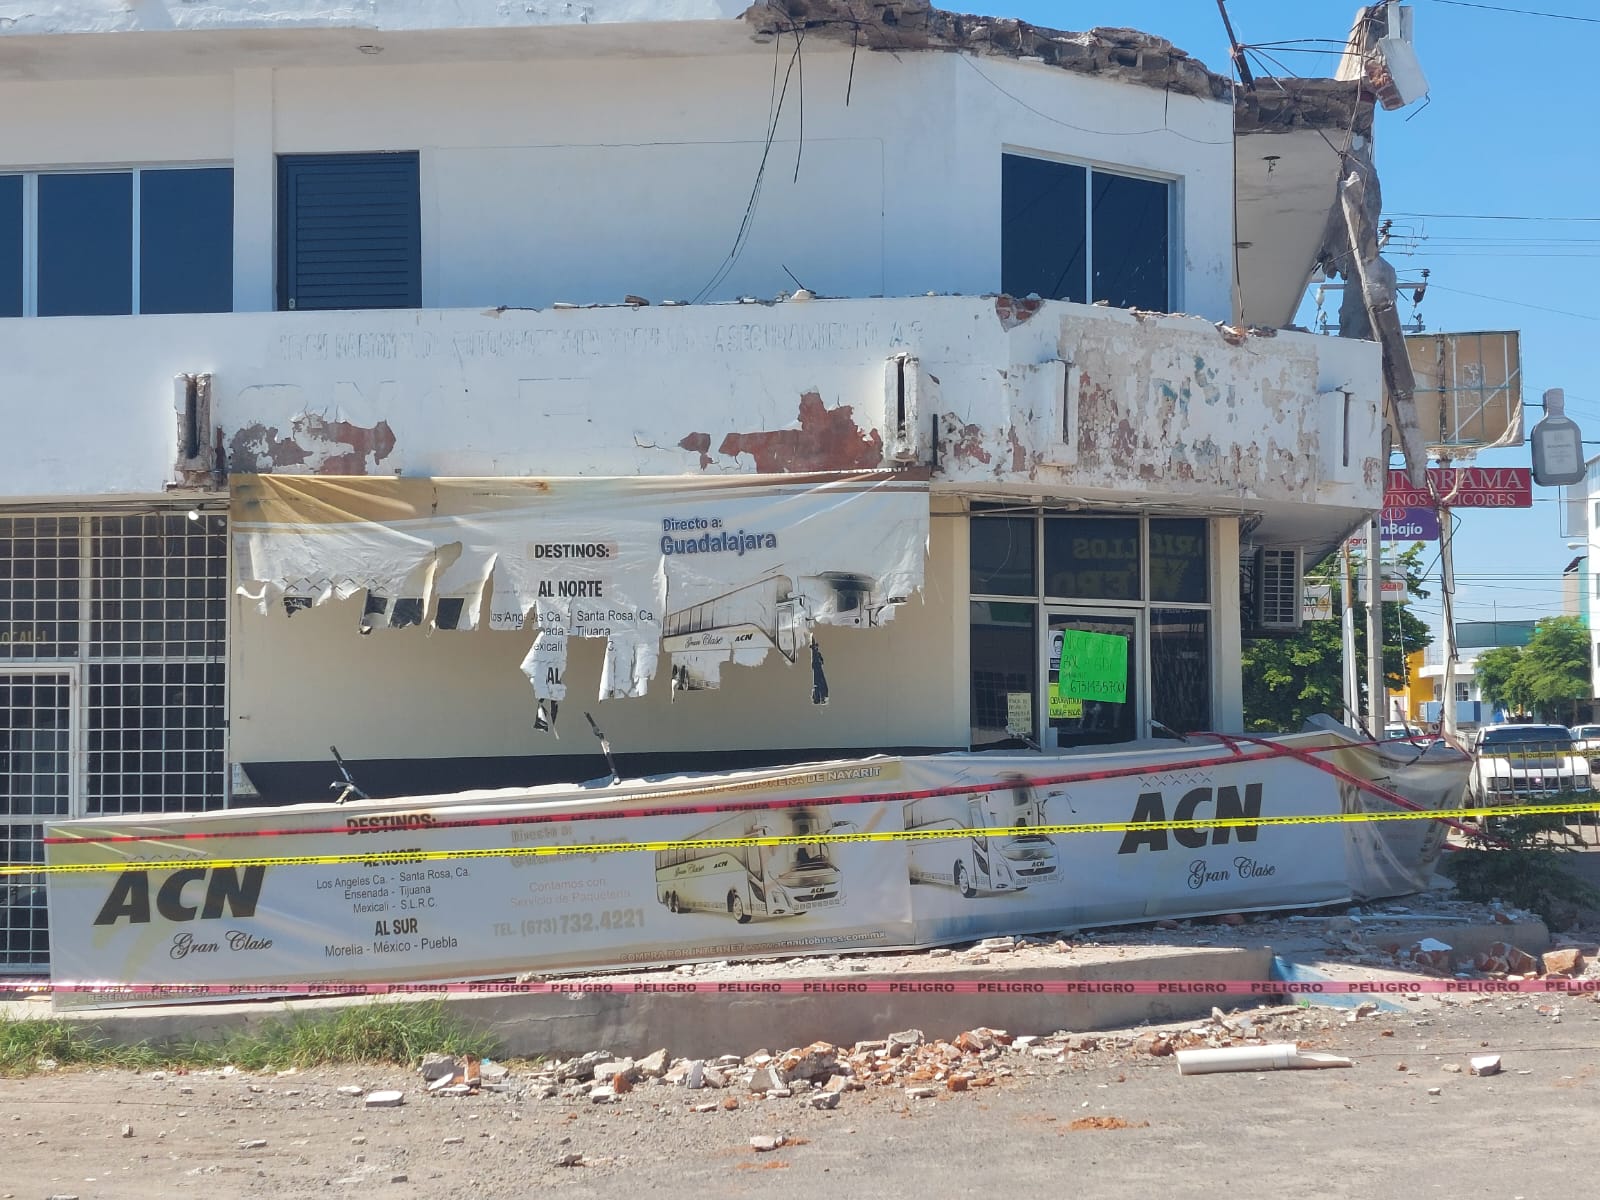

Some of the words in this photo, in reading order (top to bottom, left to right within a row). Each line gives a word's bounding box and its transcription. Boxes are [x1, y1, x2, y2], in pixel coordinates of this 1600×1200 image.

[663, 518, 708, 532] Directo
[711, 519, 722, 530] a:
[1381, 522, 1423, 537] nBajío
[534, 543, 610, 559] DESTINOS:
[660, 529, 777, 556] Guadalajara
[538, 581, 555, 598] AL
[558, 580, 603, 597] NORTE
[576, 610, 605, 621] Santa
[608, 610, 636, 623] Rosa,
[639, 610, 655, 621] Ca.
[533, 641, 563, 652] exicali
[546, 667, 562, 685] AL
[827, 767, 881, 781] NAYARIT
[1118, 782, 1263, 854] ACN
[316, 879, 332, 889] Los
[334, 876, 370, 889] Angeles
[399, 871, 425, 882] Santa
[427, 869, 453, 881] Rosa,
[1188, 859, 1230, 889] Gran
[1233, 856, 1276, 878] Clase
[93, 864, 266, 925] ACN
[344, 888, 389, 900] Ensenada
[400, 885, 431, 897] Tijuana
[353, 902, 389, 913] Mexicali
[375, 920, 391, 936] AL
[393, 918, 418, 934] SUR
[170, 932, 220, 959] Gran
[225, 930, 273, 952] Clase
[325, 943, 363, 957] Morelia
[373, 939, 411, 954] México
[421, 936, 458, 950] Puebla
[388, 984, 448, 993] PELIGRO
[469, 984, 530, 993] PELIGRO
[551, 984, 613, 993] PELIGRO
[634, 983, 697, 993] PELIGRO
[718, 983, 782, 993] PELIGRO
[803, 983, 867, 993] PELIGRO
[889, 983, 955, 993] PELIGRO
[977, 983, 1044, 993] PELIGRO
[1067, 983, 1135, 993] PELIGRO
[1158, 983, 1227, 993] PELIGRO
[1251, 983, 1323, 993] PELIGRO
[1349, 982, 1421, 992] PELIGRO
[1446, 982, 1520, 992] PELIGRO
